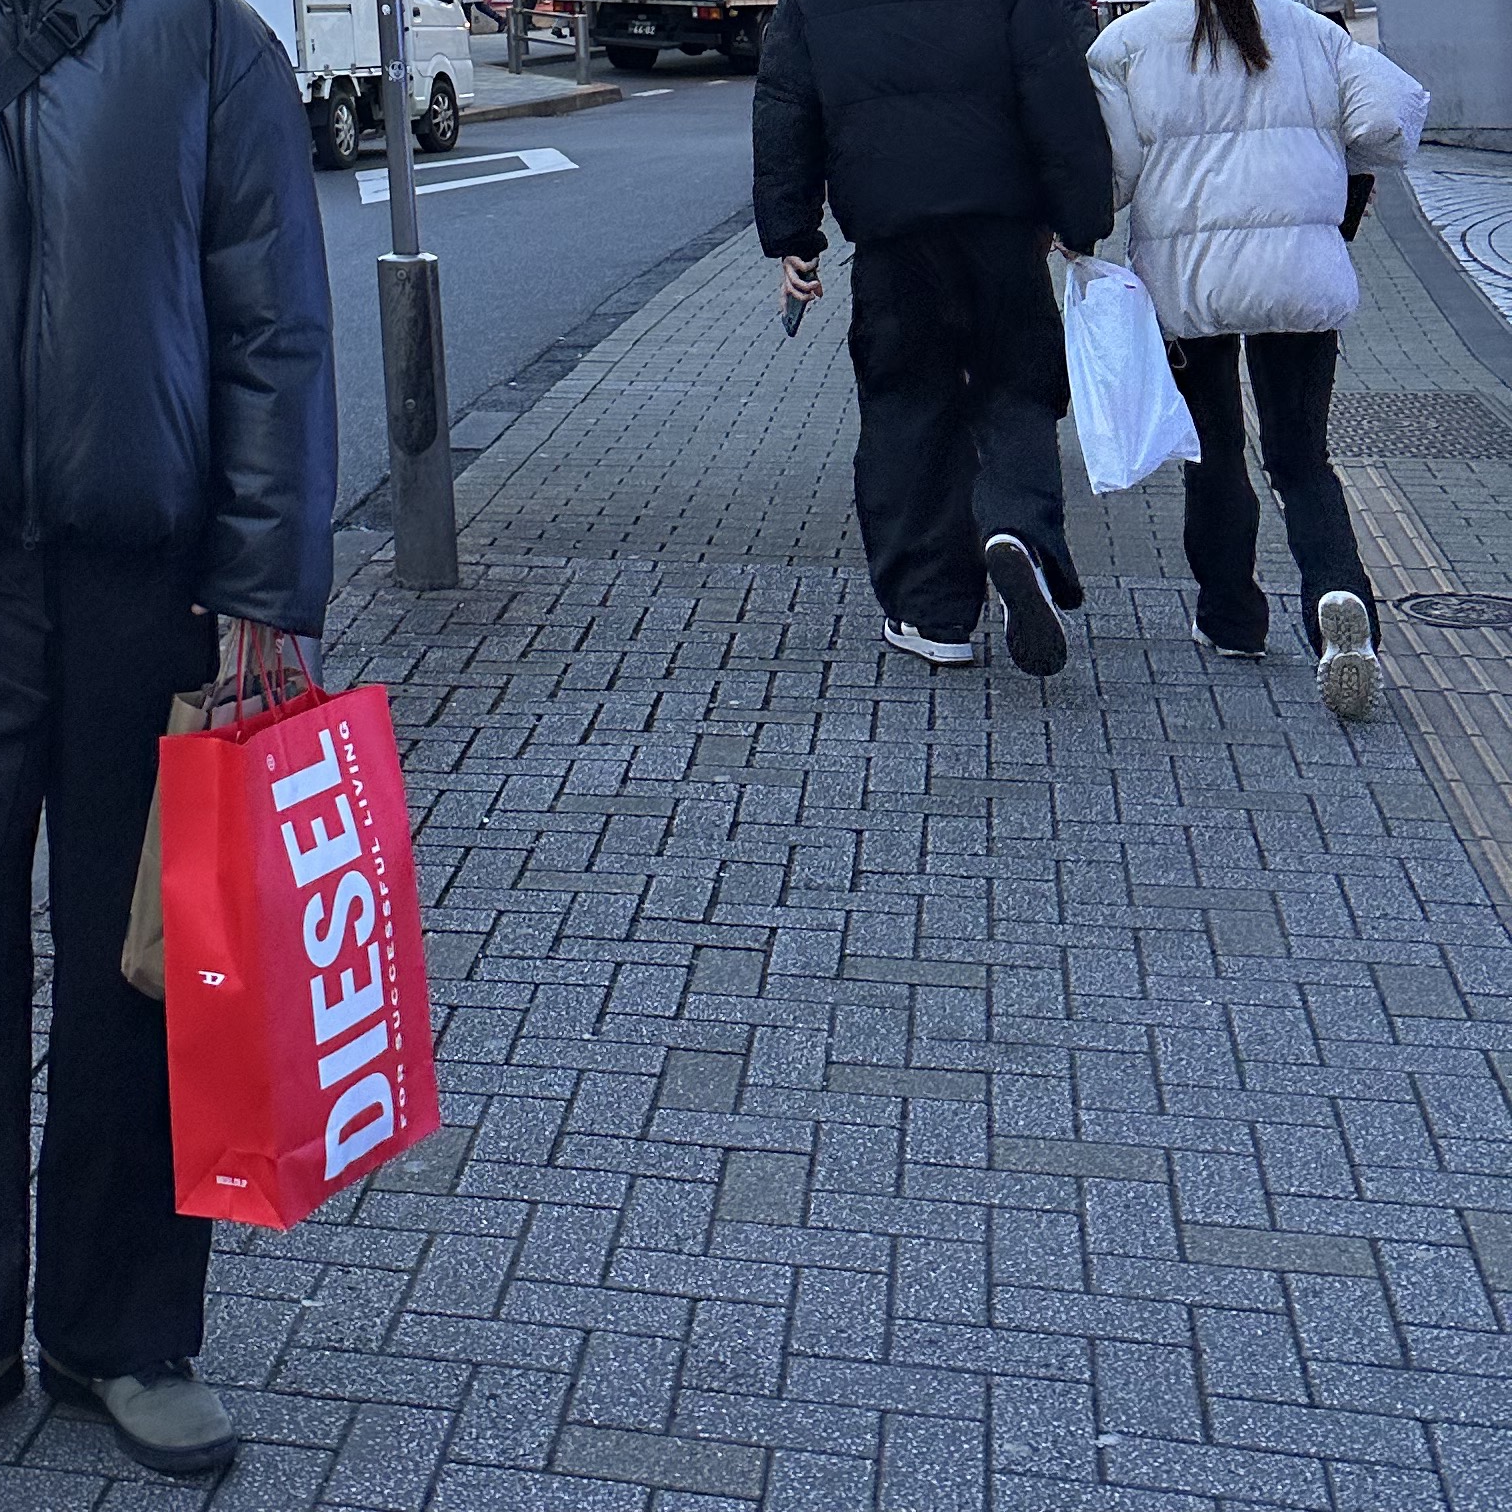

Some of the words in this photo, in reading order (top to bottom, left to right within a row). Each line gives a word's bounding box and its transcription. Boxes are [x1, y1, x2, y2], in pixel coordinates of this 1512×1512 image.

[338, 720, 376, 828] LIVING
[270, 728, 394, 1181] DIESEL
[371, 834, 403, 1052] SUCCESSFUL
[392, 1064, 409, 1130] FOR
